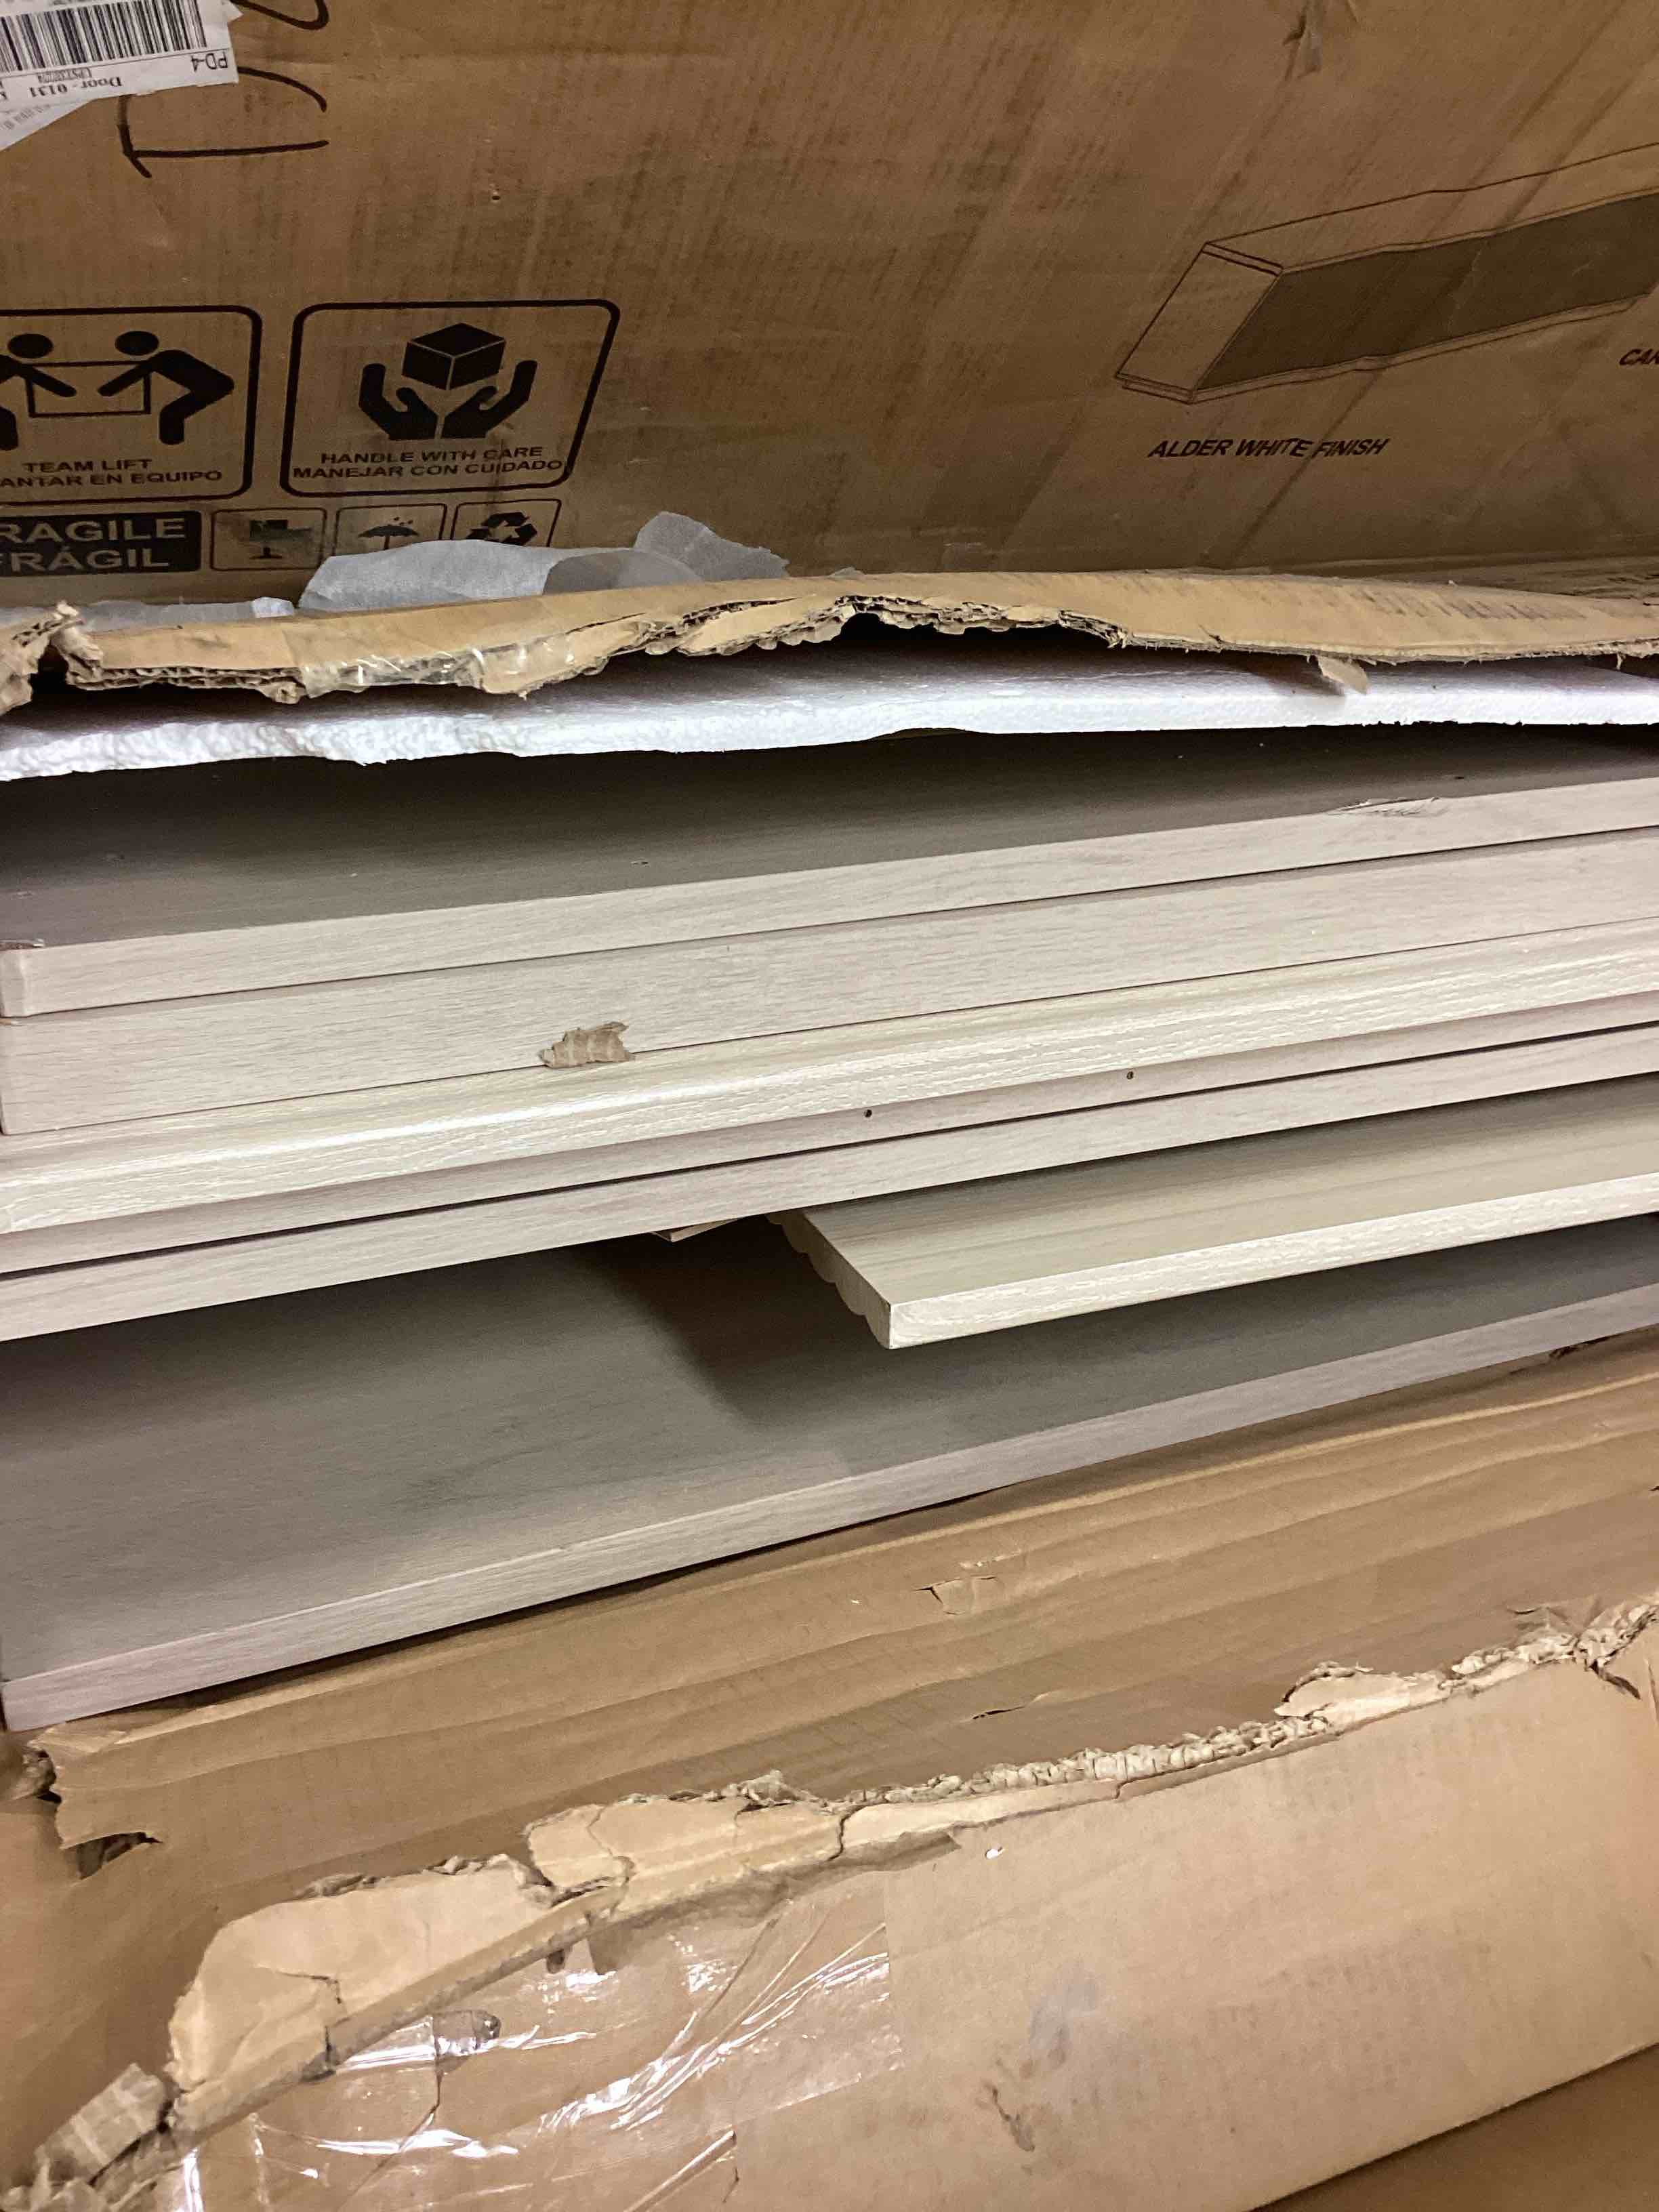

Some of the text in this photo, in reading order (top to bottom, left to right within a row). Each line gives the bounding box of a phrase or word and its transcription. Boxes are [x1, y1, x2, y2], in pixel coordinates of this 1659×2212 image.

[190, 51, 229, 72] PD-4
[81, 76, 123, 89] Door
[321, 446, 544, 465] HANDLE WITH CARE
[1147, 438, 1390, 458] ALDER WHITE FINISH
[22, 458, 152, 474] TEAM LIFT
[292, 459, 563, 479] MANEJAR CON CUIDADO
[0, 470, 223, 487] ANTAR EN EQUIPO
[0, 545, 169, 573] RÁGIL
